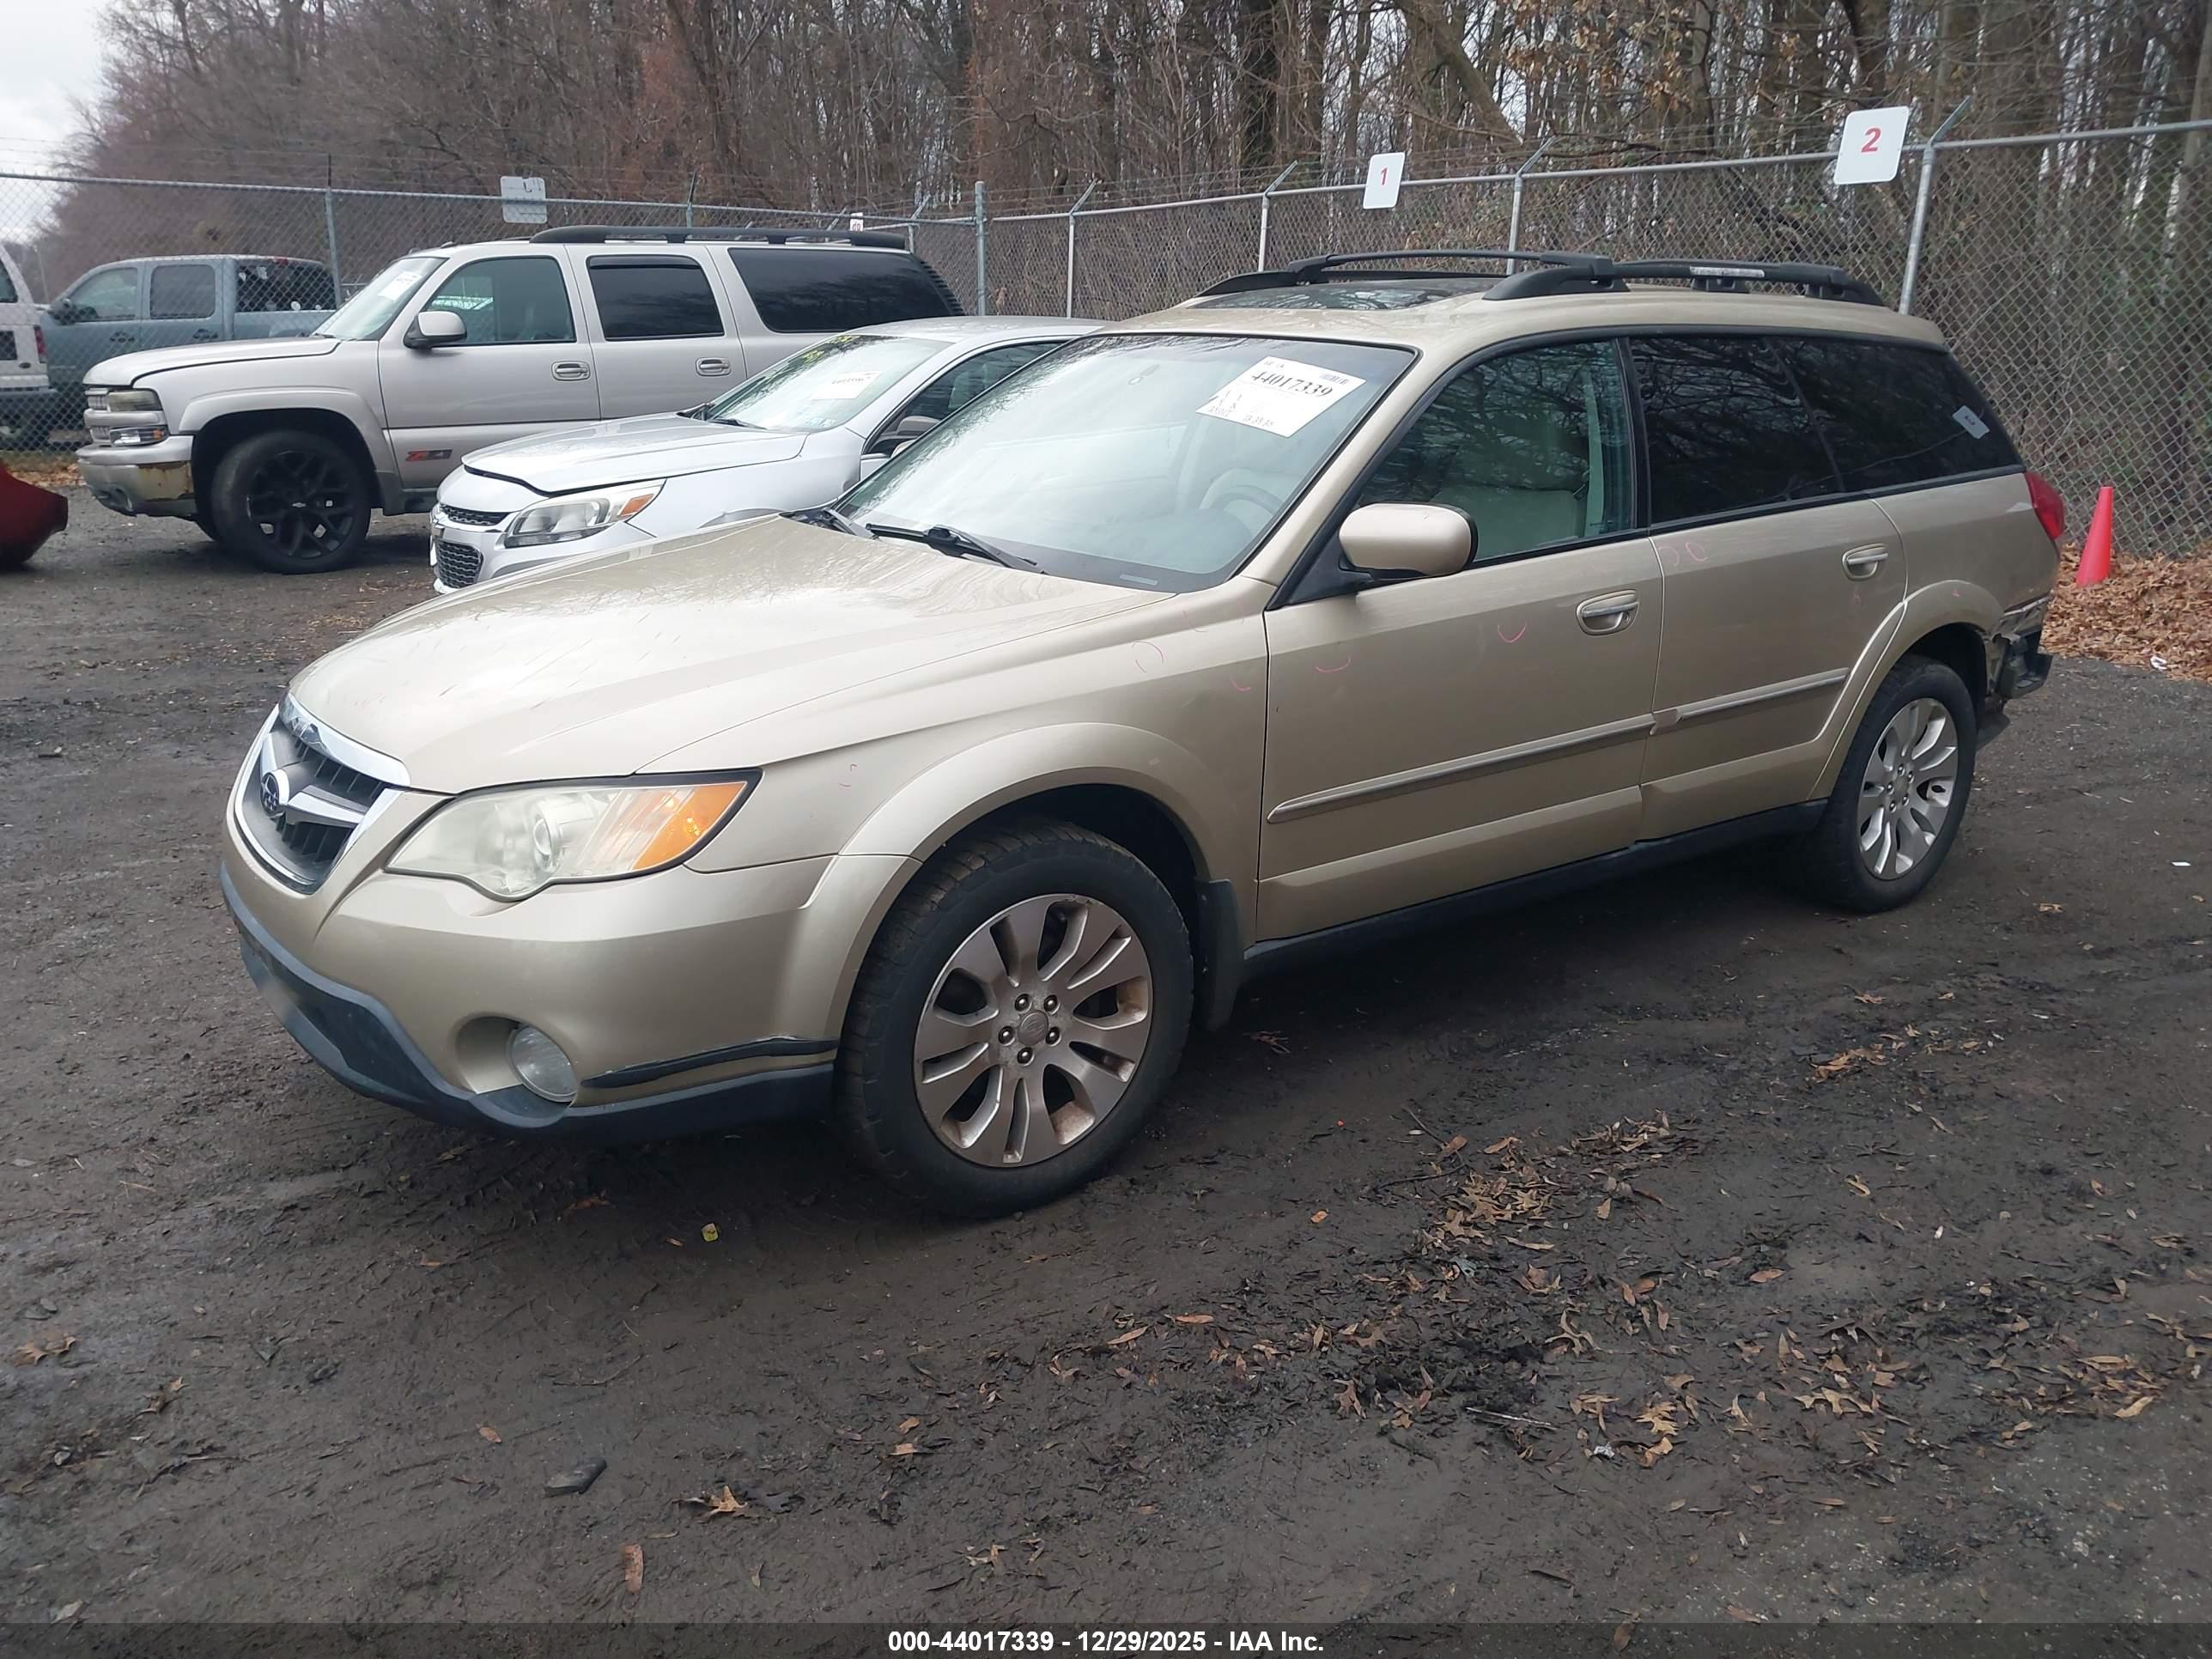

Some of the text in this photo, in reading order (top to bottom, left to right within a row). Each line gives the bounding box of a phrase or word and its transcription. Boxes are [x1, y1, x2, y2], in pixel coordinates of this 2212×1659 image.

[1861, 127, 1881, 153] 2
[1381, 167, 1388, 185] 1
[1251, 370, 1334, 398] 44017339
